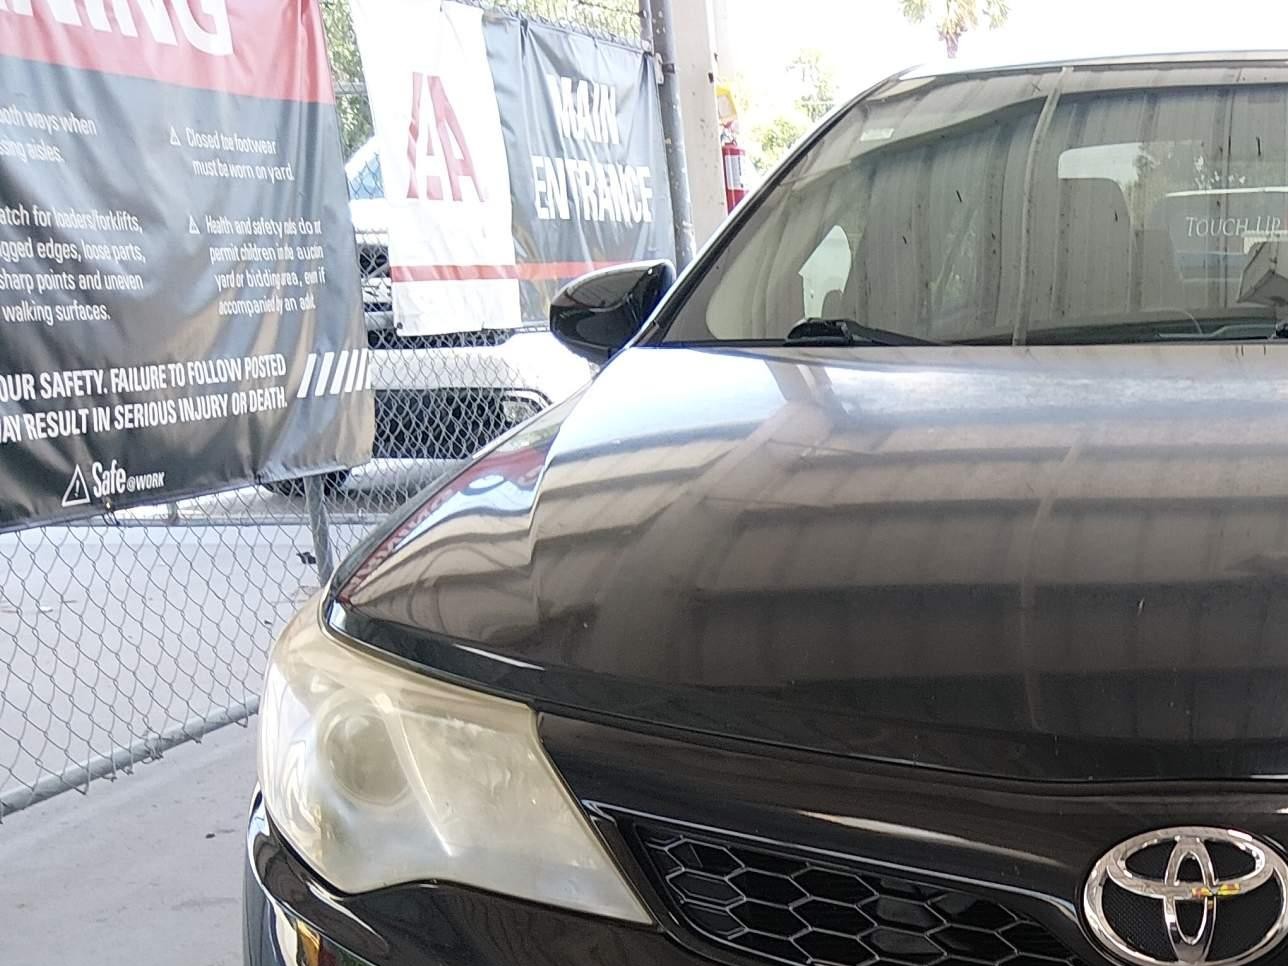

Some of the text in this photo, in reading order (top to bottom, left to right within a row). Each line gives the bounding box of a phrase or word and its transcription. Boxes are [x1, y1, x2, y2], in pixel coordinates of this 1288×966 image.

[546, 73, 619, 145] MAIN
[24, 112, 60, 135] ways
[60, 112, 97, 136] when
[185, 127, 277, 154] Closed toe footwear
[192, 159, 219, 178] must
[217, 158, 229, 178] be
[229, 163, 255, 180] worn
[255, 165, 267, 180] on
[529, 155, 653, 227] ENTRANCE
[32, 204, 53, 228] for
[205, 215, 234, 235] Health
[235, 217, 252, 235] and
[252, 217, 283, 239] safety
[298, 217, 313, 235] do
[1185, 214, 1281, 239] TOUCH UP
[36, 236, 82, 263] edges,
[81, 239, 110, 260] loose
[111, 243, 146, 264] parts,
[209, 243, 240, 264] permit
[240, 242, 277, 261] children
[0, 267, 144, 294] sharp points and uneven
[214, 270, 235, 292] yard
[235, 273, 245, 288] or
[246, 269, 281, 290] bidding
[318, 266, 327, 285] if
[2, 299, 111, 326] walking surfaces.
[283, 297, 298, 313] an
[39, 369, 108, 400] SAFETY.
[110, 364, 167, 394] FAILURE
[168, 362, 186, 388] TO
[187, 357, 242, 386] FOLLOW
[244, 353, 287, 380] POSTED
[0, 386, 288, 444] AY RESULT IN SERIOUS INJURY OR DEATH.
